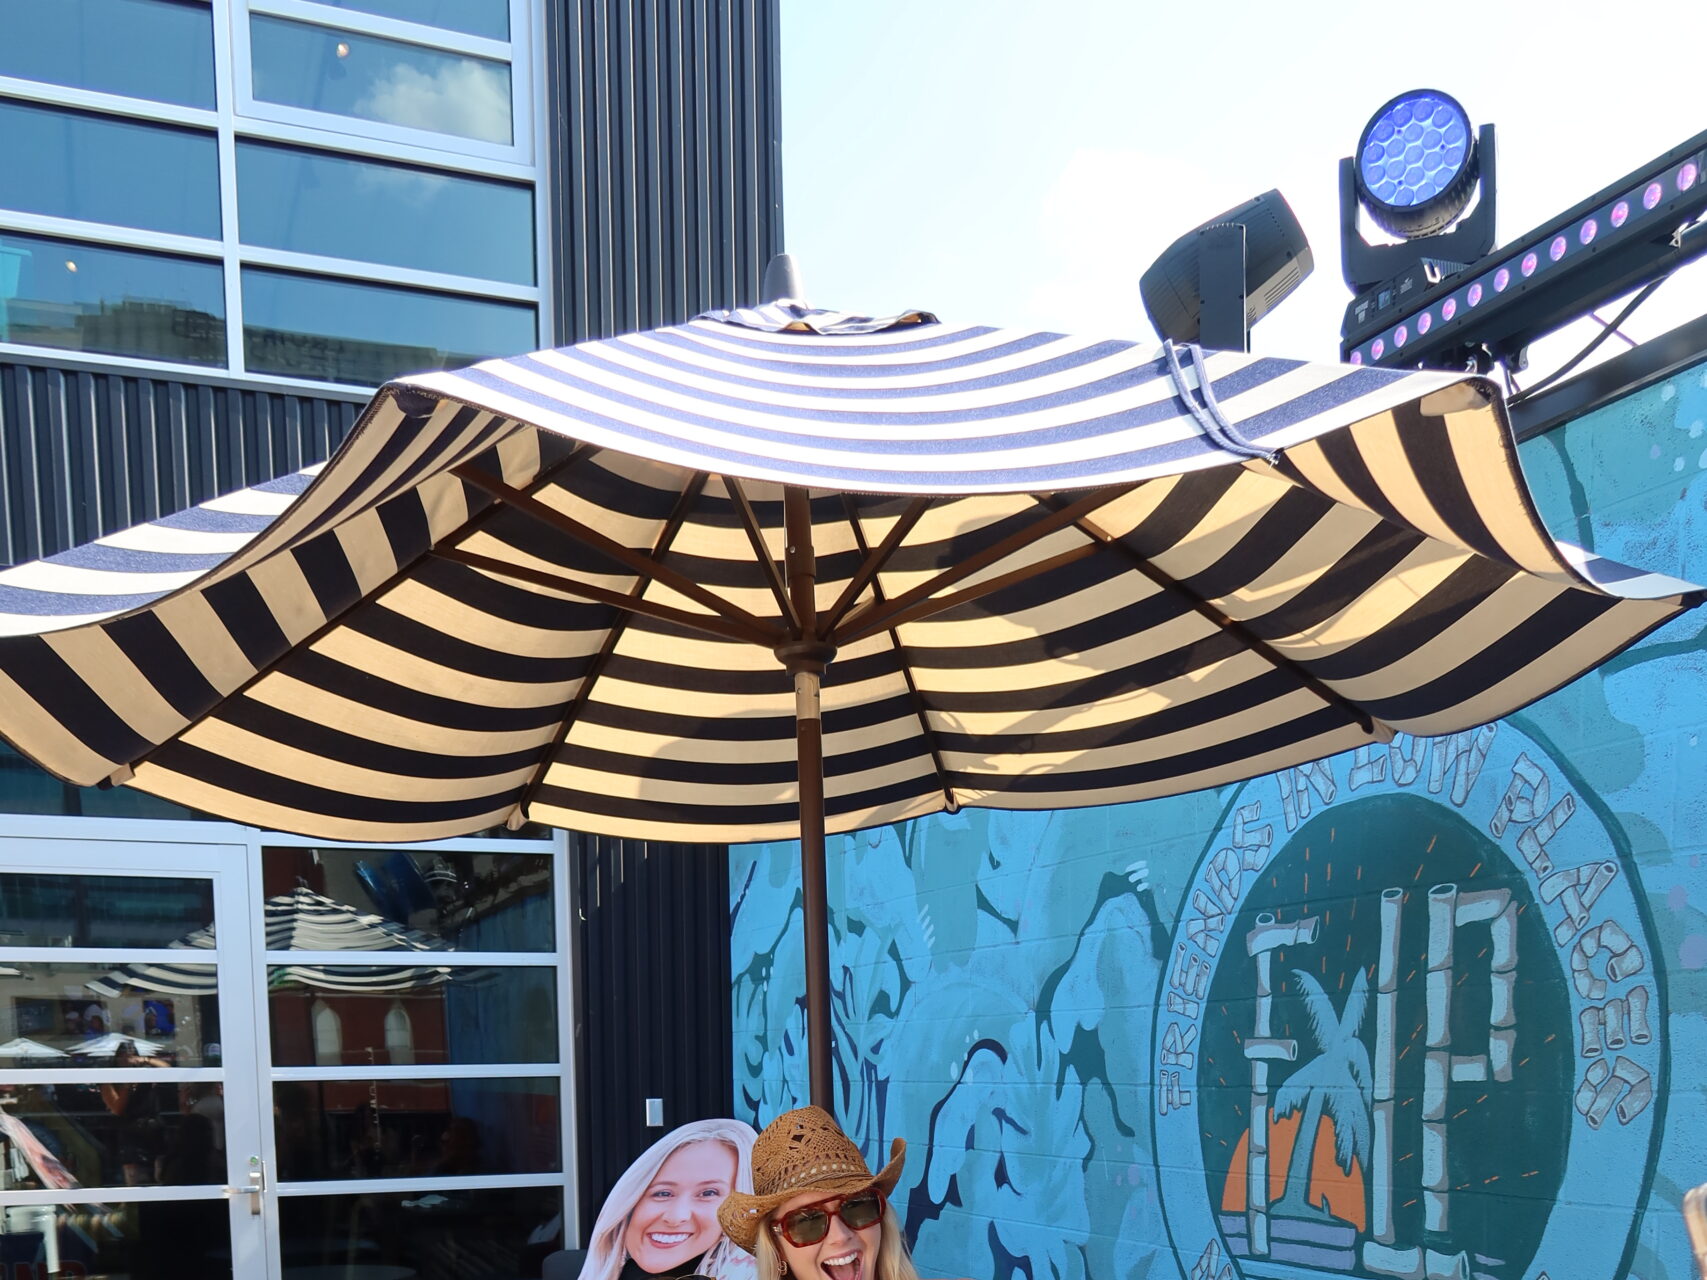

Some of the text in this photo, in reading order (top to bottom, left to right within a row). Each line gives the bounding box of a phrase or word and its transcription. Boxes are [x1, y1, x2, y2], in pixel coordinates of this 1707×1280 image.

[1159, 722, 1652, 1131] FRIENDS IN LOW PLACES
